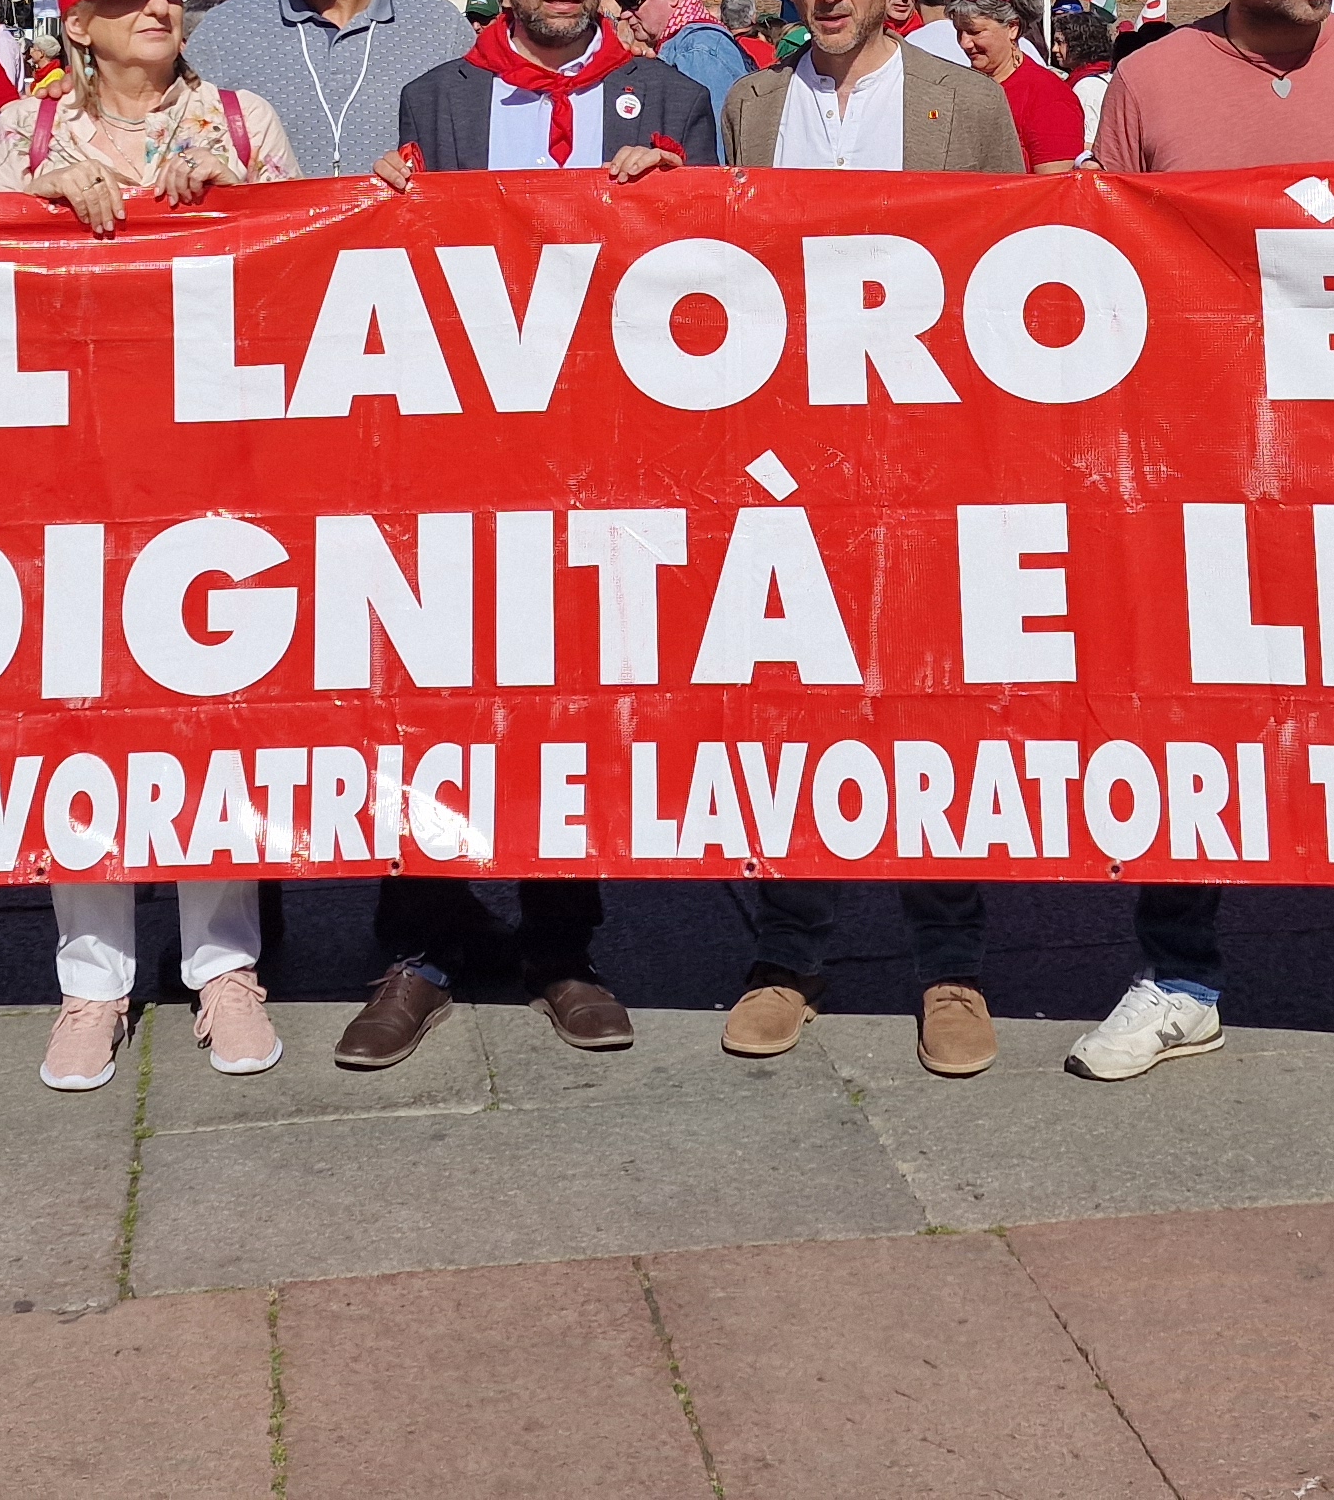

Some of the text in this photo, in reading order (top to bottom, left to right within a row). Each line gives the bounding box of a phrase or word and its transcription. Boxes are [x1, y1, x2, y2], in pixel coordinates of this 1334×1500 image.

[172, 224, 1148, 423] LAVORO
[957, 503, 1077, 684] E
[539, 742, 587, 859] E
[631, 739, 1270, 864] LAVORATORI
